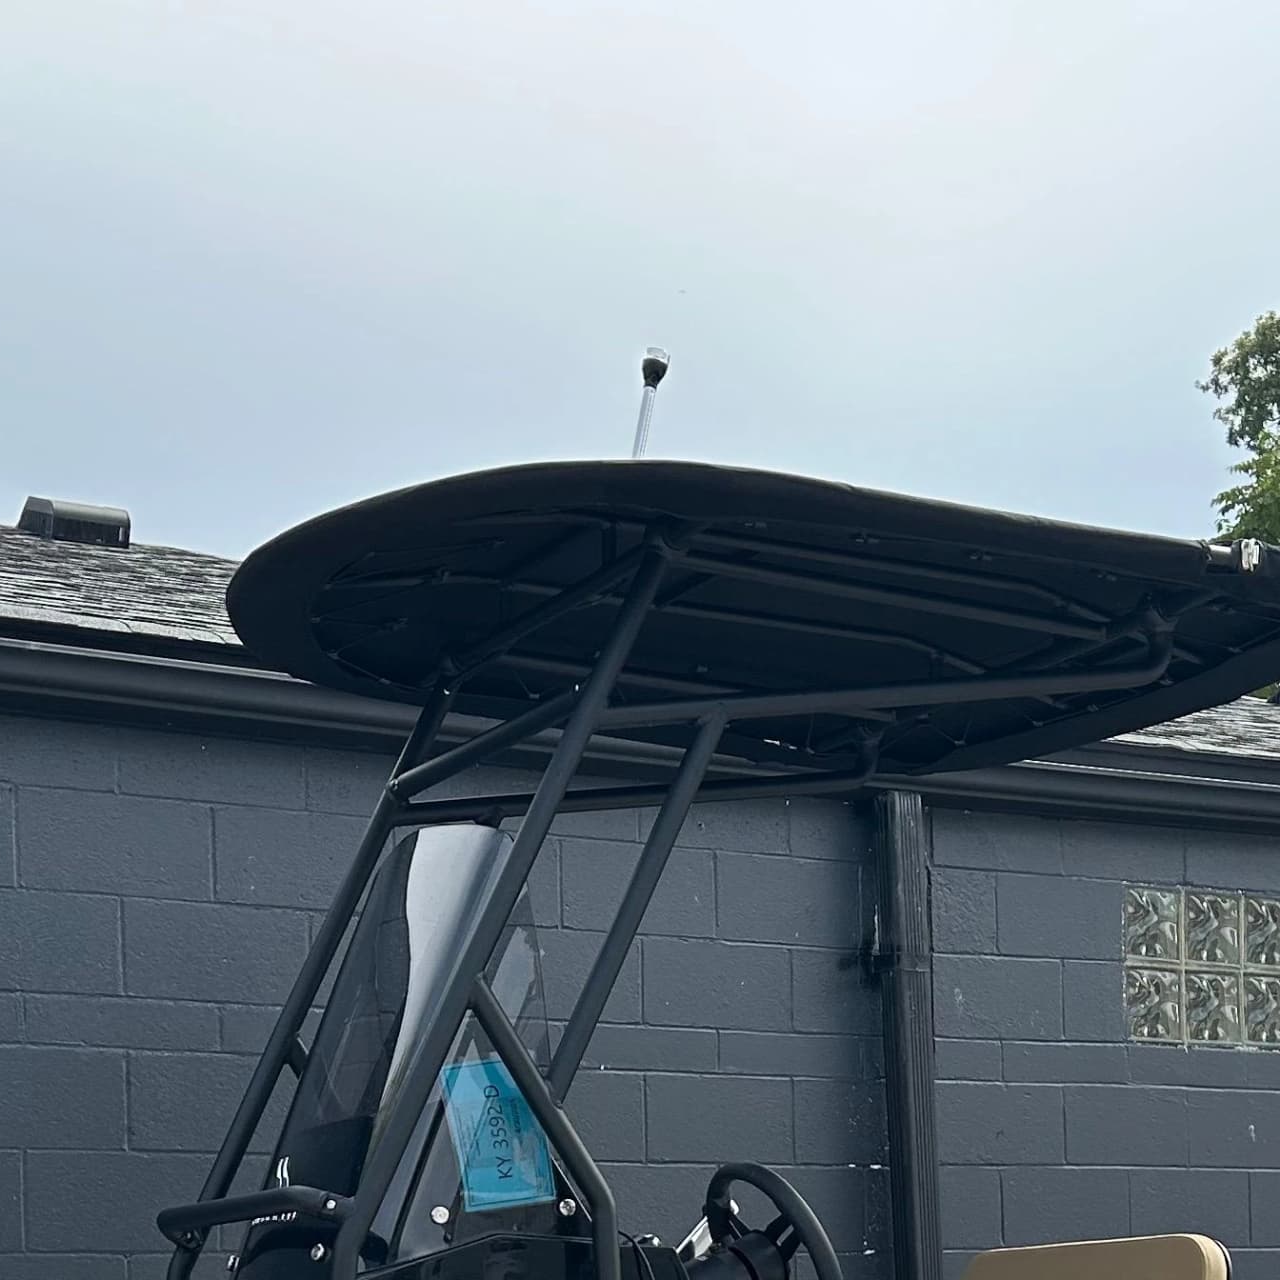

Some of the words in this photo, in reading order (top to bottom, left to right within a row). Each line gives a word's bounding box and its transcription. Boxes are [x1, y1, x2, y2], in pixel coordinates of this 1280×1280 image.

[483, 1085, 500, 1099] D
[487, 1105, 509, 1150] 3592
[495, 1156, 513, 1180] KY
